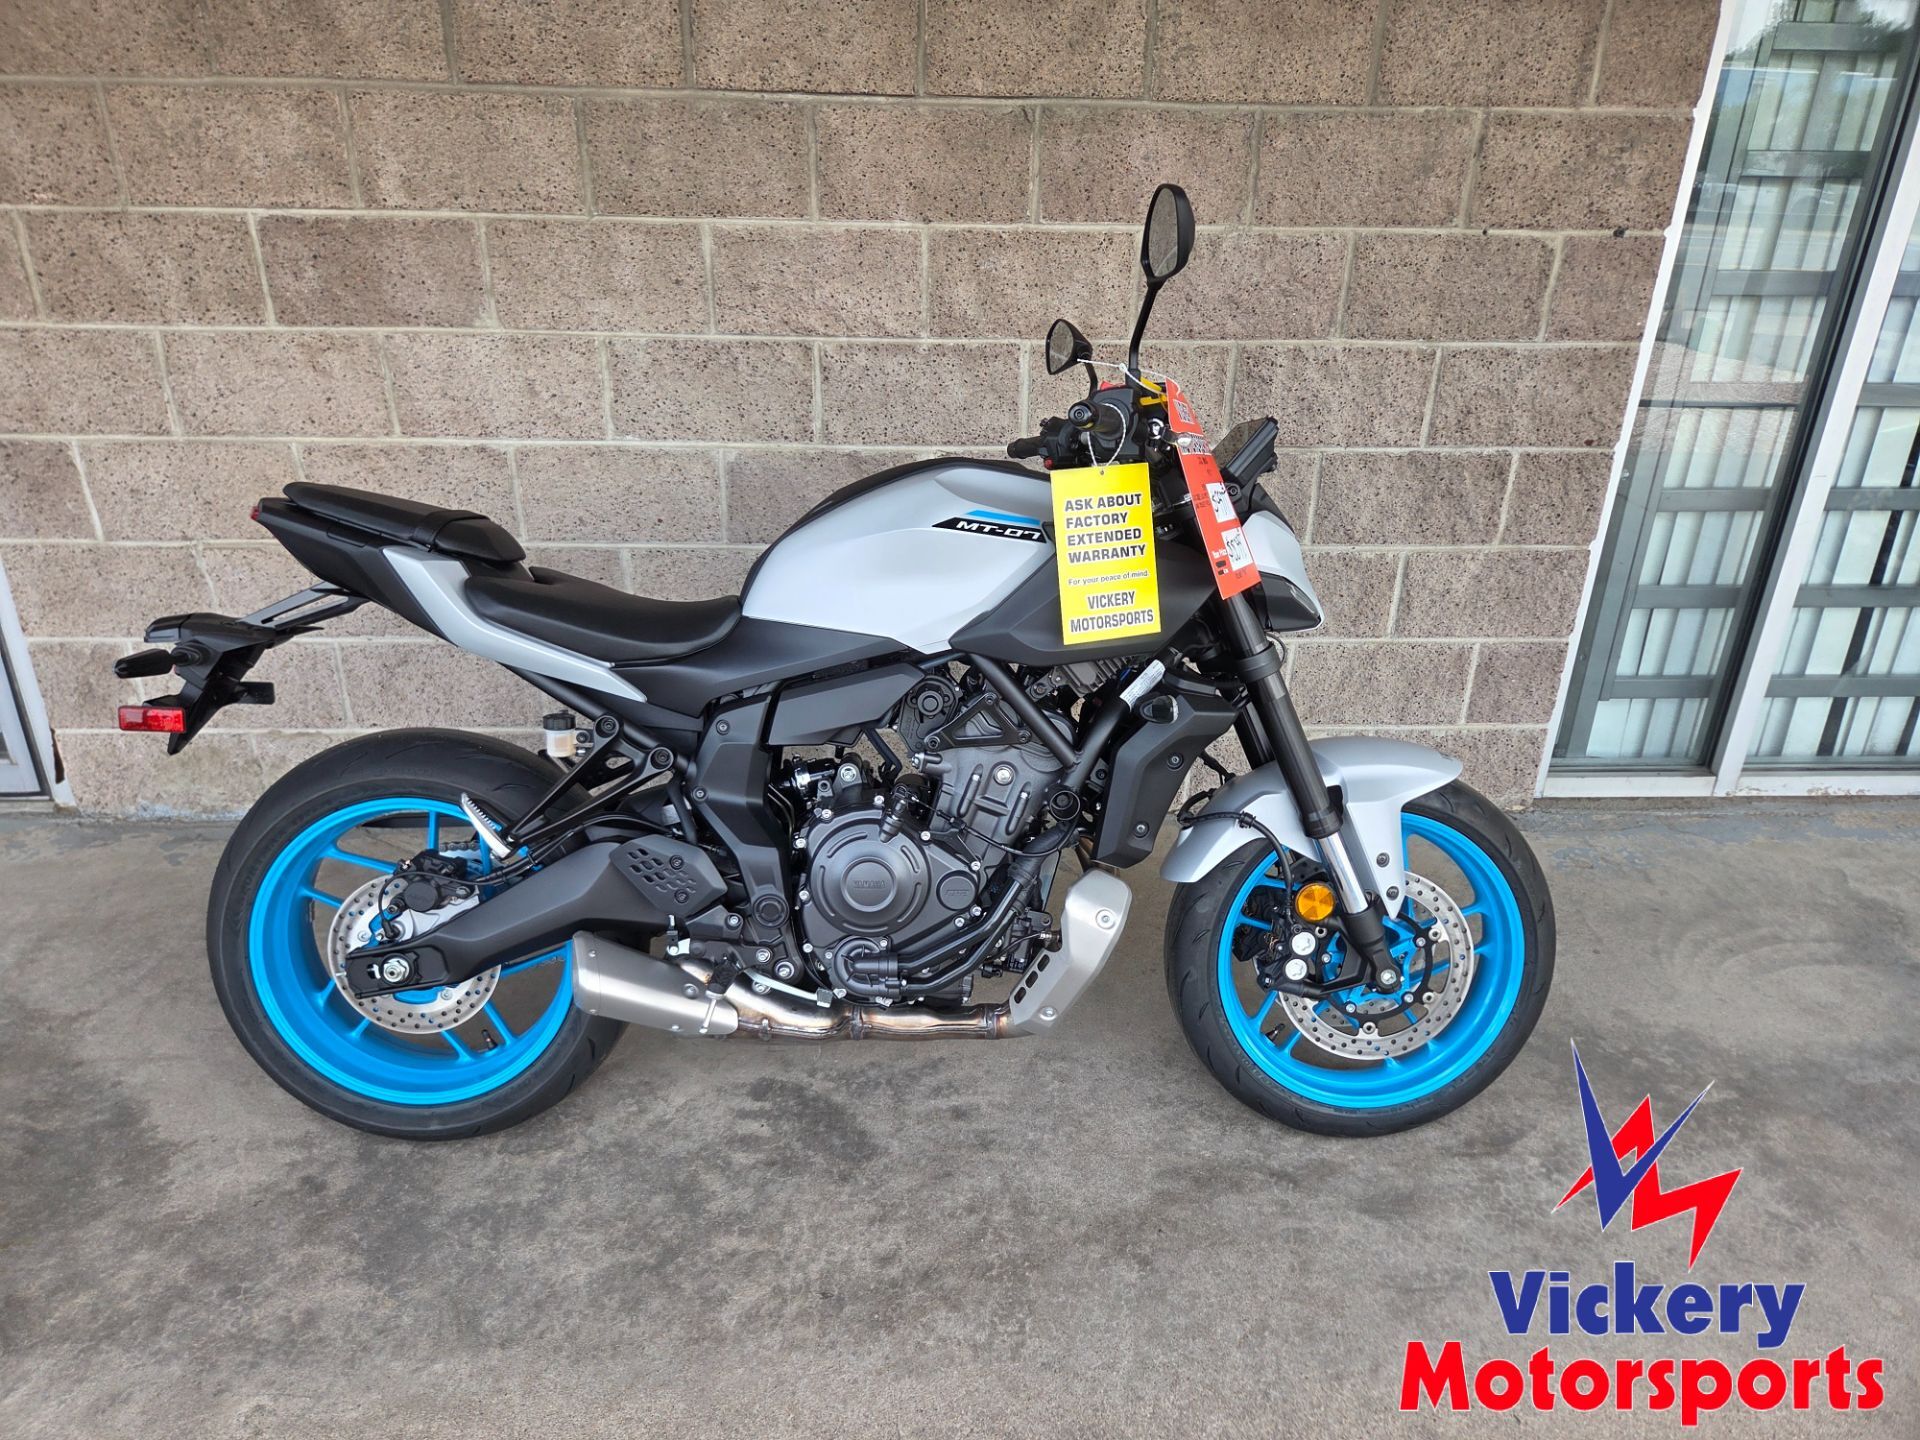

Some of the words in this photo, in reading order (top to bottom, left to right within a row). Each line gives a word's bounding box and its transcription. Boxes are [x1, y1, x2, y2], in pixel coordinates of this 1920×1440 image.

[1065, 498, 1094, 511] ASK
[1097, 493, 1142, 509] ABOUT
[956, 520, 1041, 540] MT-07
[1066, 512, 1128, 529] FACTORY
[1067, 528, 1142, 547] EXTENDED
[1068, 545, 1146, 564] WARRANTY
[1068, 578, 1080, 586] For
[1082, 577, 1099, 586] your
[1100, 574, 1121, 584] peace
[1122, 572, 1130, 580] of
[1087, 591, 1136, 610] VICKERY
[1070, 610, 1154, 633] MOTORSPORTS
